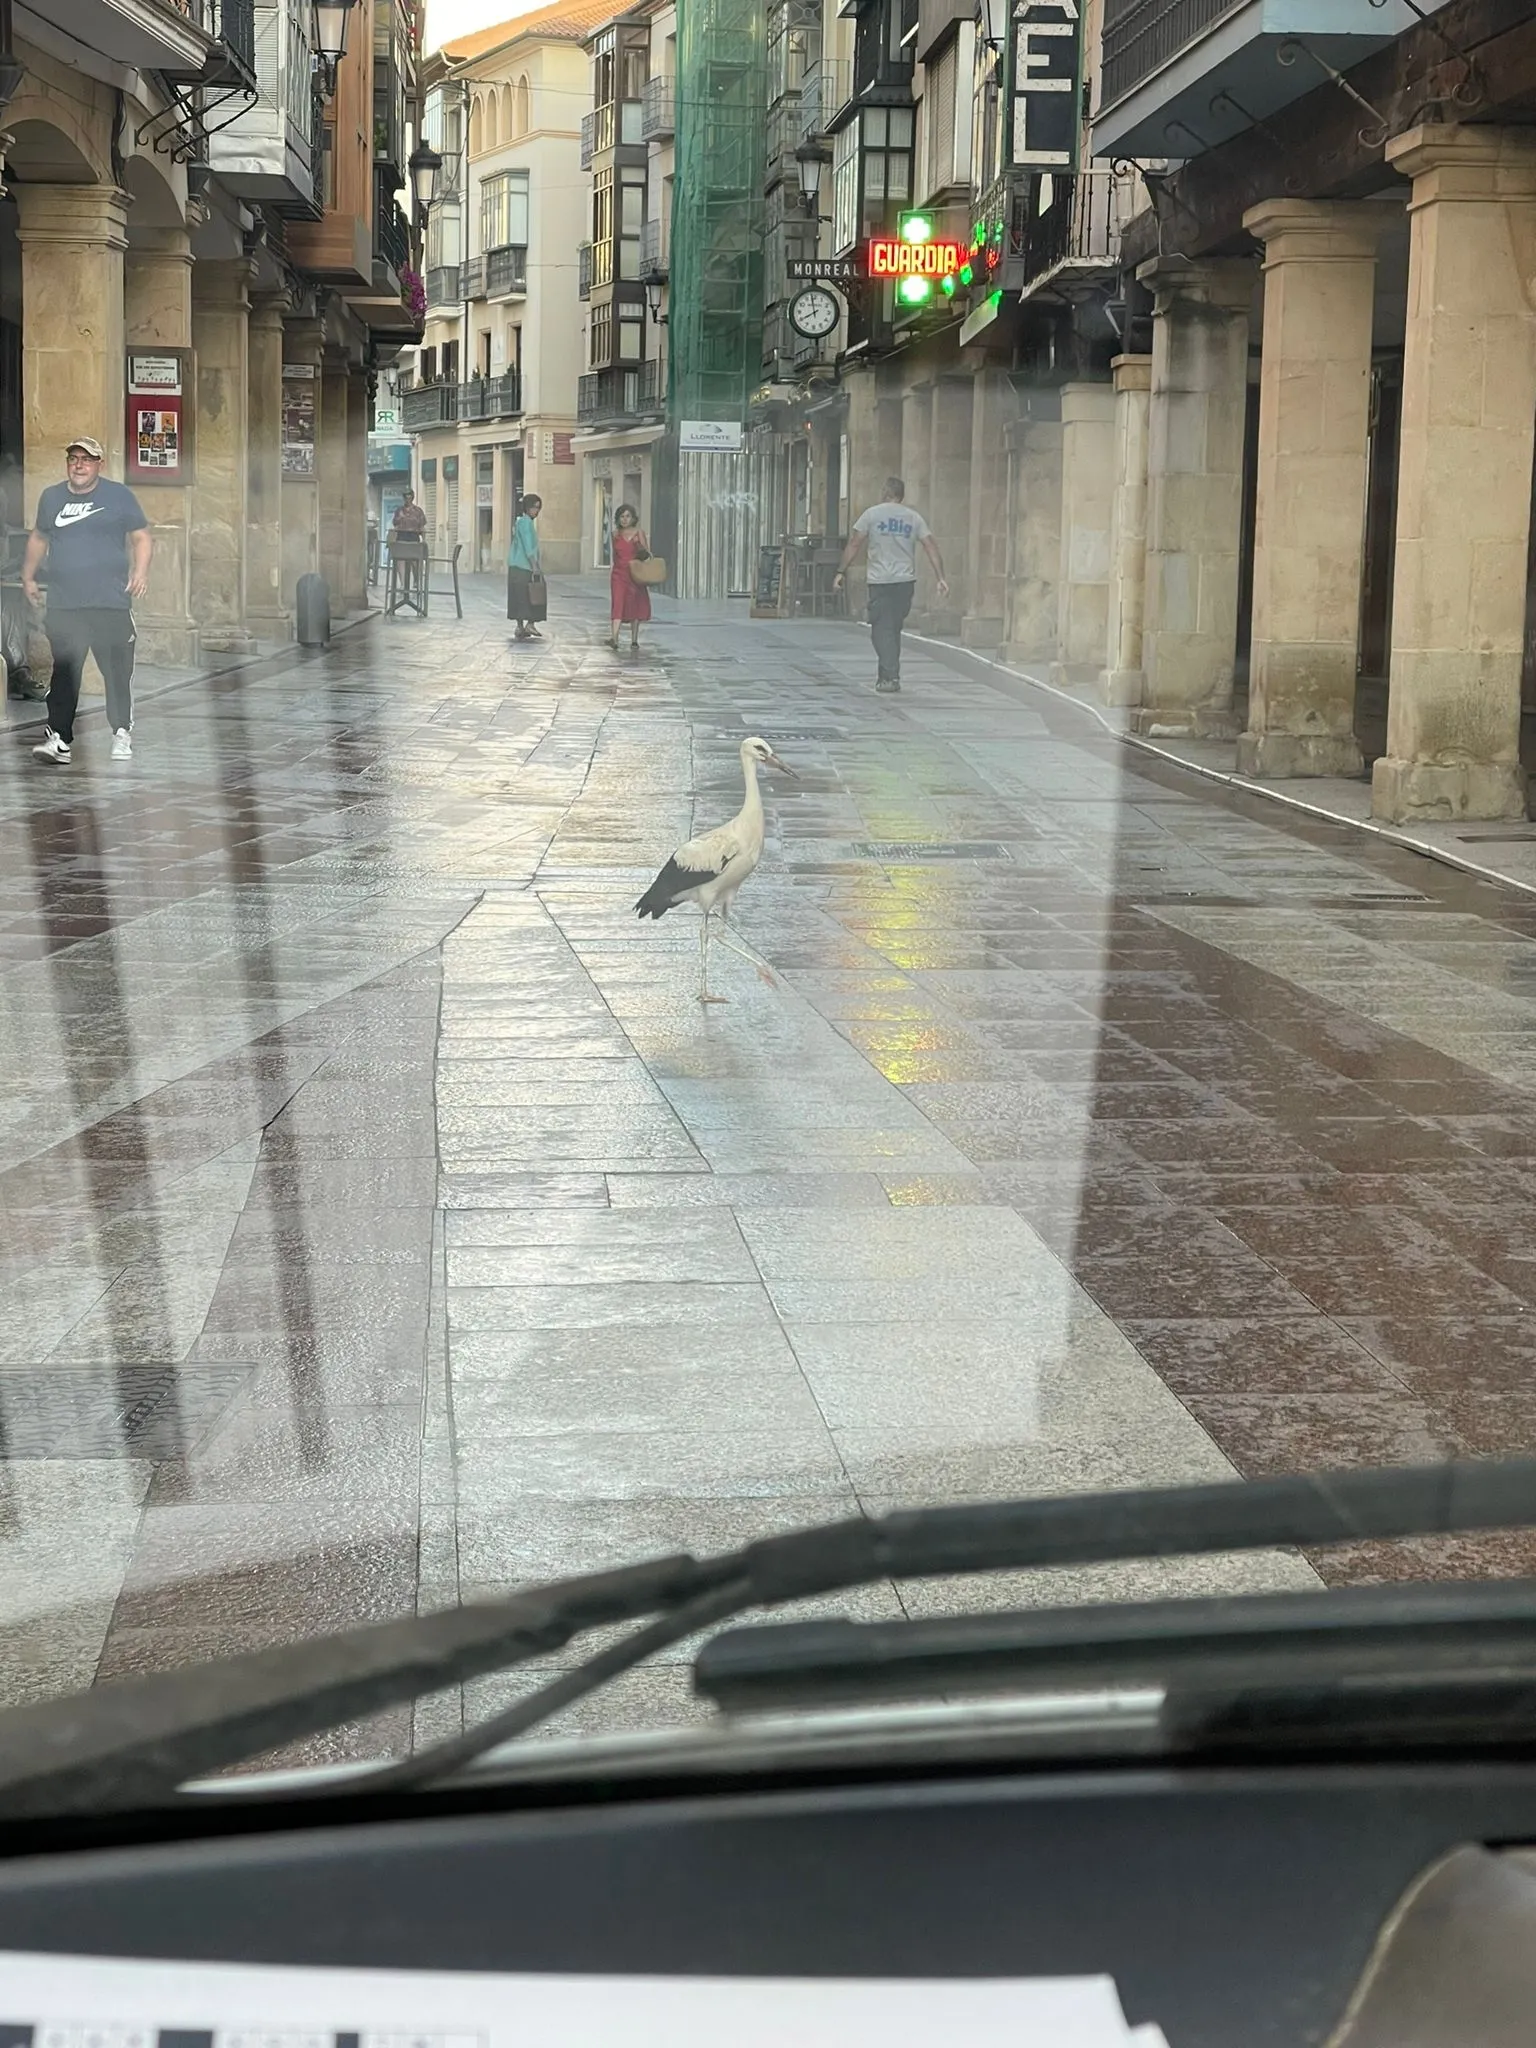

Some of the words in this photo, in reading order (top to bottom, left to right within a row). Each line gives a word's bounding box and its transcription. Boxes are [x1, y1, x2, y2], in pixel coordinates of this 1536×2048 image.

[1012, 0, 1080, 165] EL
[873, 243, 957, 275] GUARDIA
[794, 263, 860, 276] MONREAL
[690, 433, 731, 441] LLORENTE
[60, 502, 94, 516] NIKE
